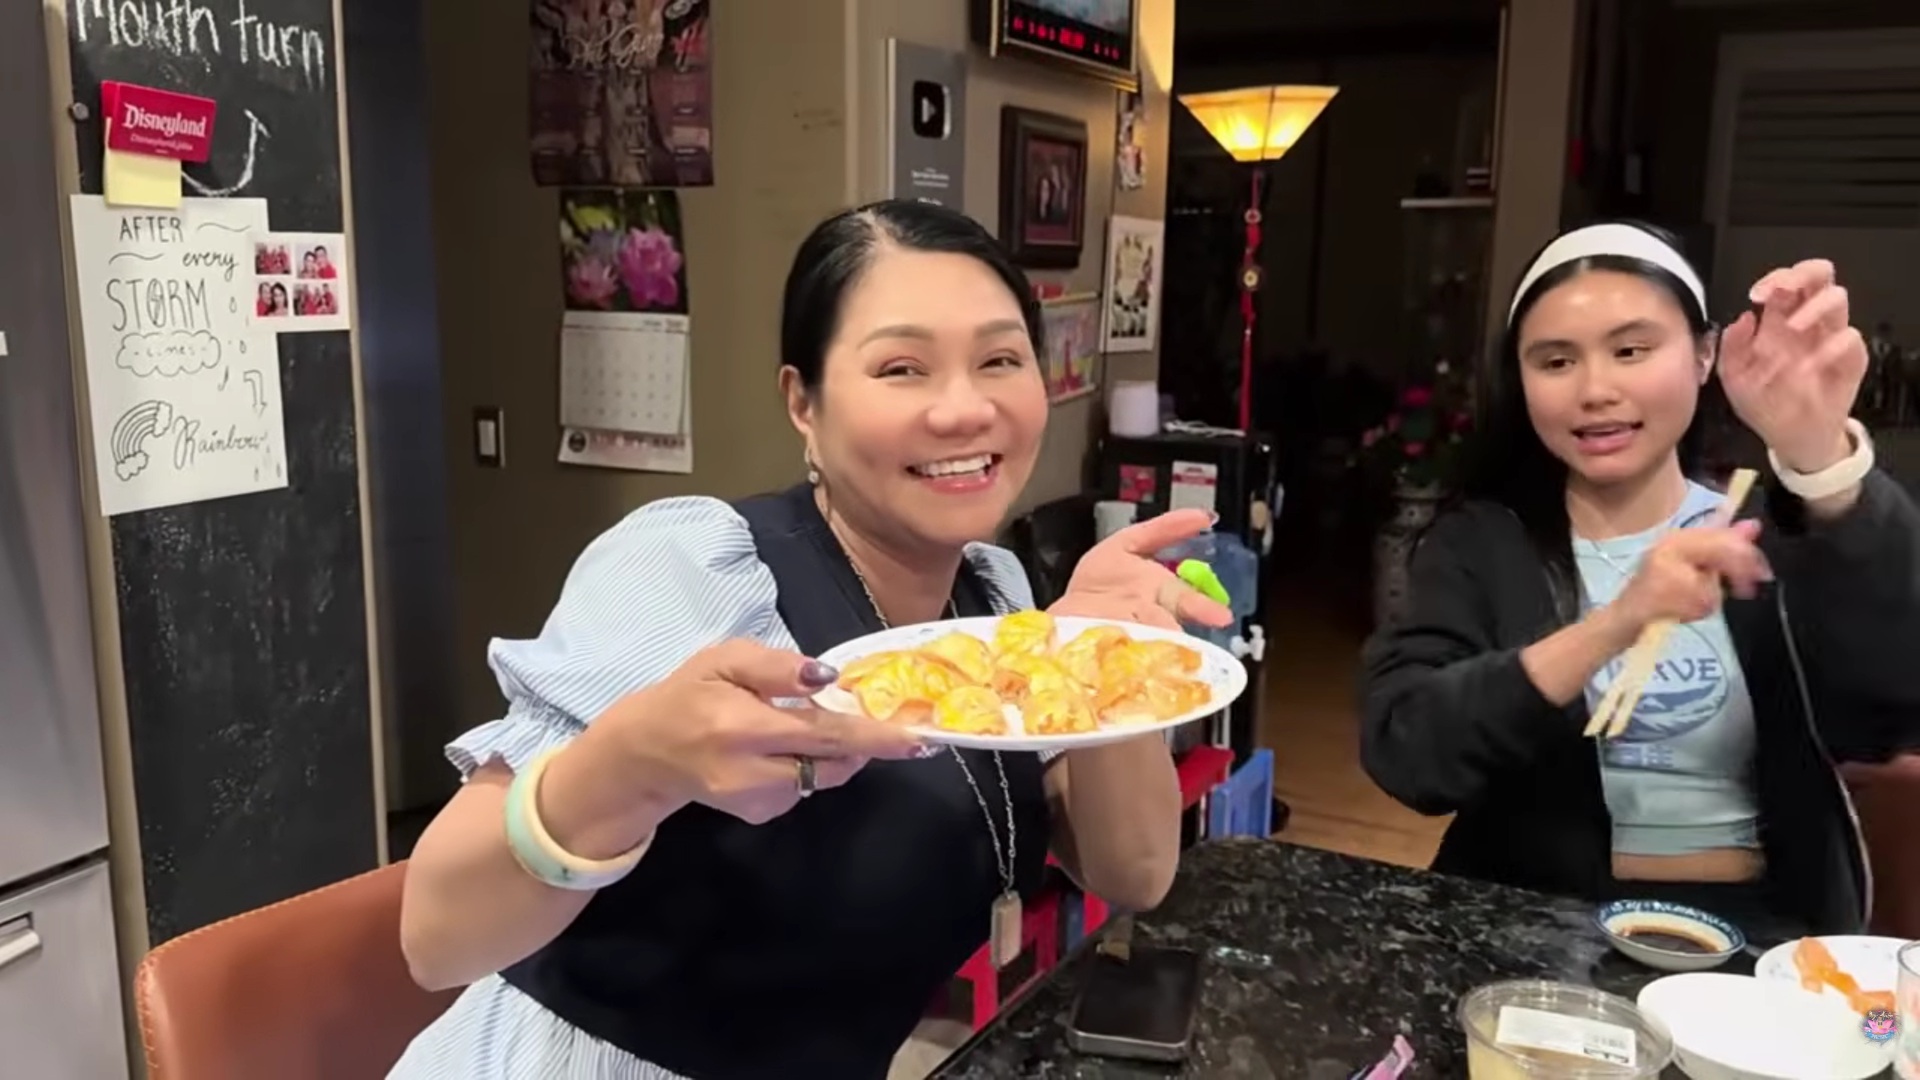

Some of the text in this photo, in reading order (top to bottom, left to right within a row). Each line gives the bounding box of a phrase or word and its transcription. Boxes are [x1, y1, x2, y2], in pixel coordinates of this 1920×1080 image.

[231, 0, 326, 90] turn
[122, 102, 207, 138] Disneyland
[119, 215, 184, 243] AFTER
[182, 252, 239, 282] every
[106, 278, 211, 332] STORM
